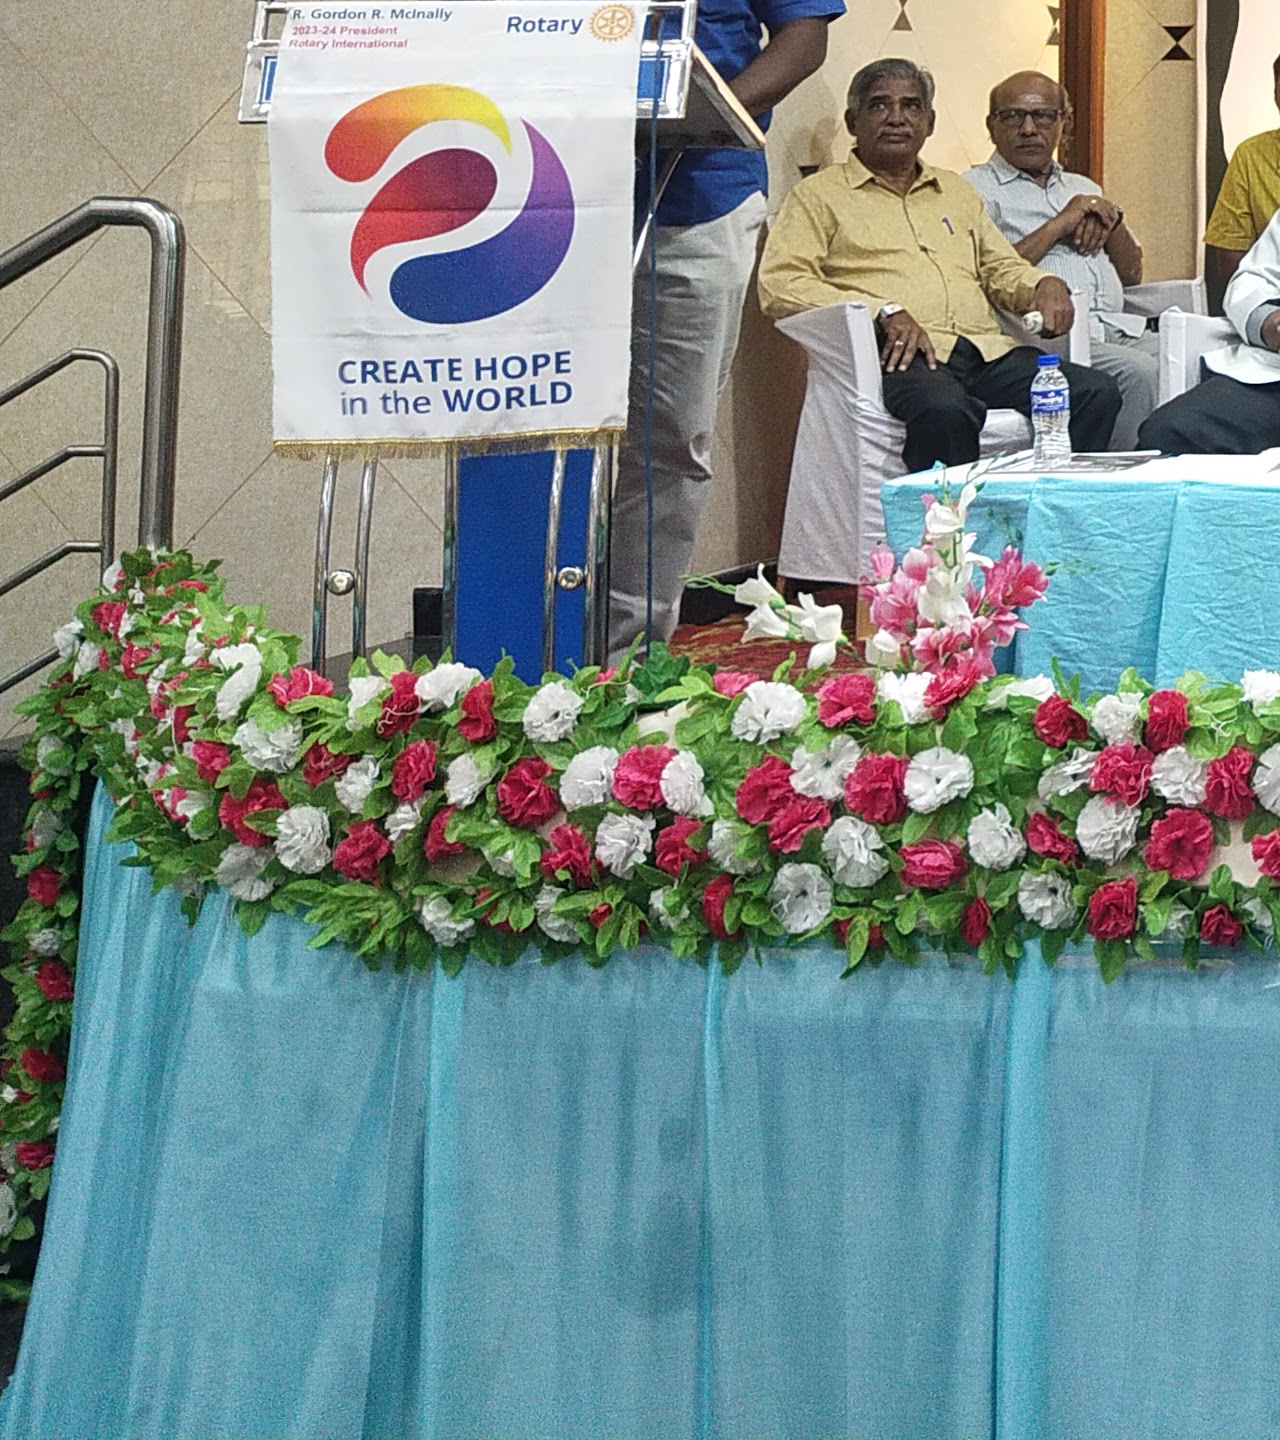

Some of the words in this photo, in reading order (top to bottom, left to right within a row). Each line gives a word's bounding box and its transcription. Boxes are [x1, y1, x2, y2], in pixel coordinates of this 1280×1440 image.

[292, 9, 306, 20] R.
[311, 9, 366, 20] Gordon
[371, 9, 385, 20] R.
[390, 8, 453, 22] McInally
[292, 26, 337, 35] 2023-24
[340, 26, 398, 35] President
[506, 15, 584, 35] Rotary
[288, 39, 329, 50] Rotary
[332, 39, 408, 49] International
[338, 358, 463, 384] CREATE
[475, 350, 572, 382] HOPE
[341, 391, 368, 416] in
[379, 390, 431, 415] the
[442, 381, 573, 413] WORLD
